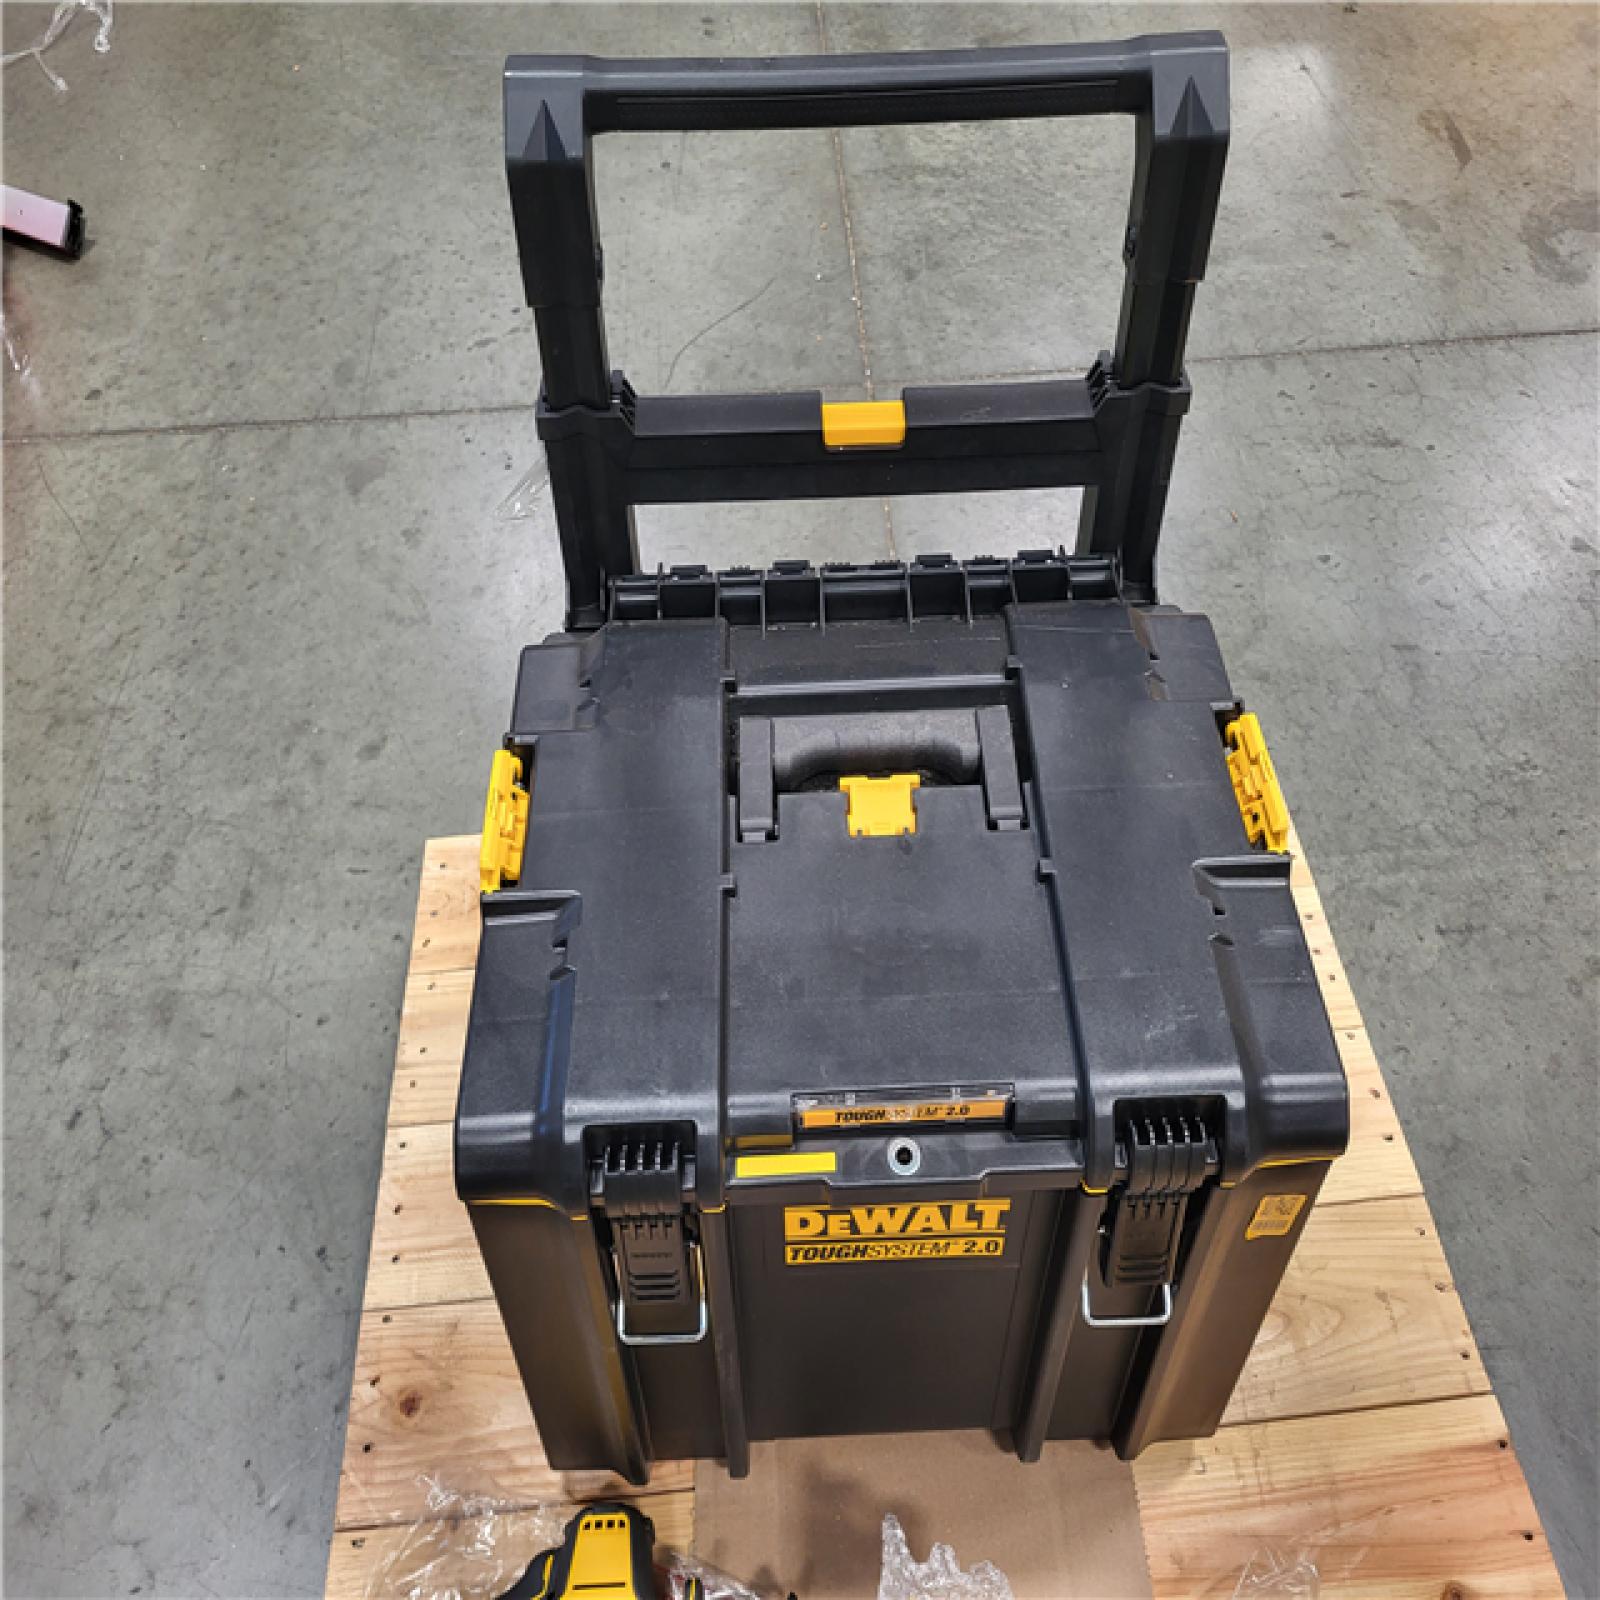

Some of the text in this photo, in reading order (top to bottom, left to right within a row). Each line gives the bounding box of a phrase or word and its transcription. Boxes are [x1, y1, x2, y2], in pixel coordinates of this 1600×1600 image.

[834, 1104, 971, 1122] TOUGHEM 2.0
[785, 1199, 1010, 1240] DEWALT
[962, 1239, 1000, 1254] 2.0
